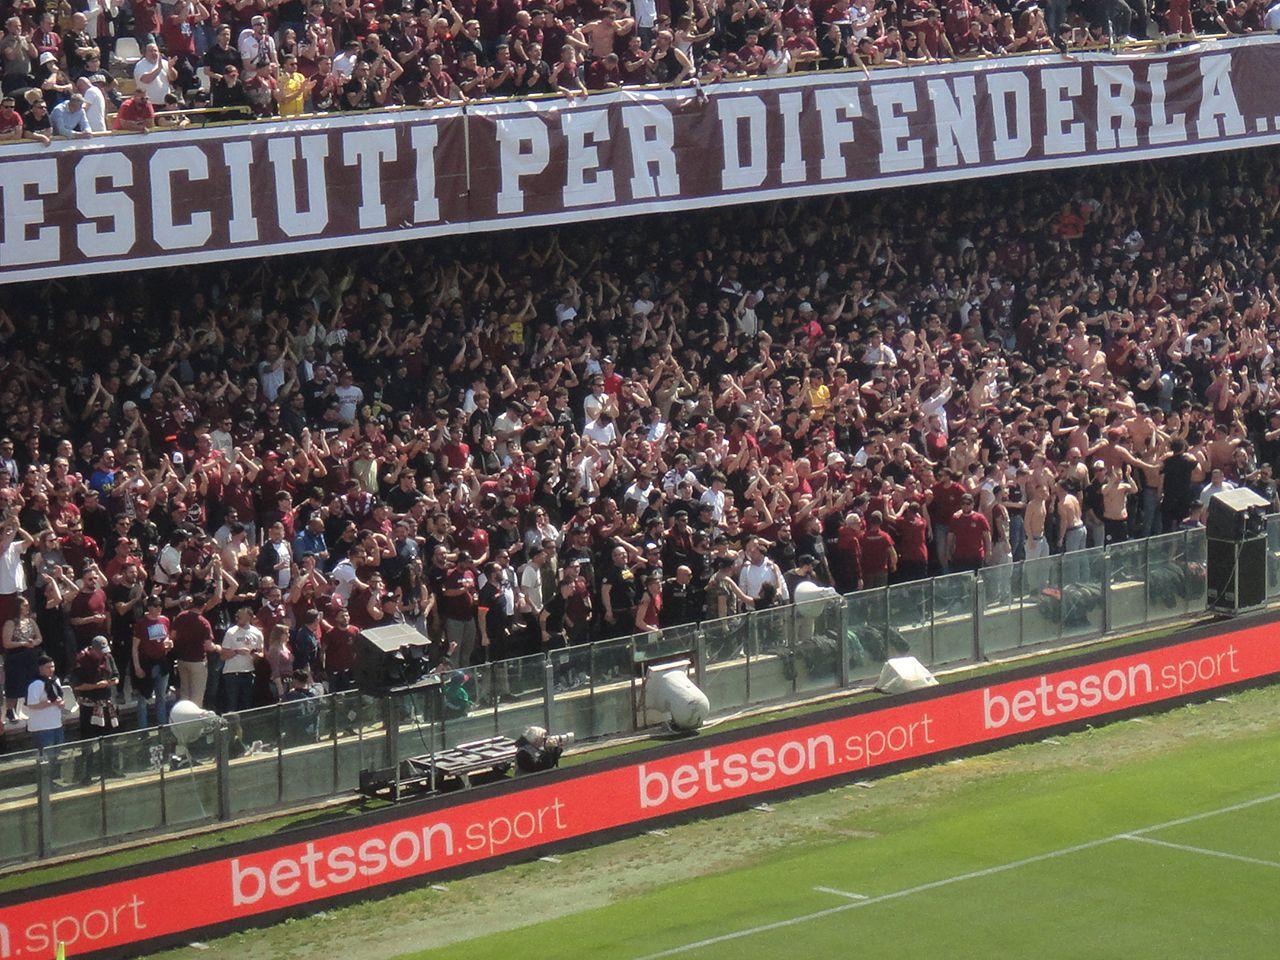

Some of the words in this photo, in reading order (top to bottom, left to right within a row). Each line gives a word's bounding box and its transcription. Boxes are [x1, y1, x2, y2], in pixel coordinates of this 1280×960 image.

[0, 124, 440, 266] ESCIUTI
[494, 102, 681, 215] PER
[983, 644, 1240, 730] betsson.sport
[638, 712, 935, 809] betsson.sport
[231, 796, 568, 907] betsson.sport
